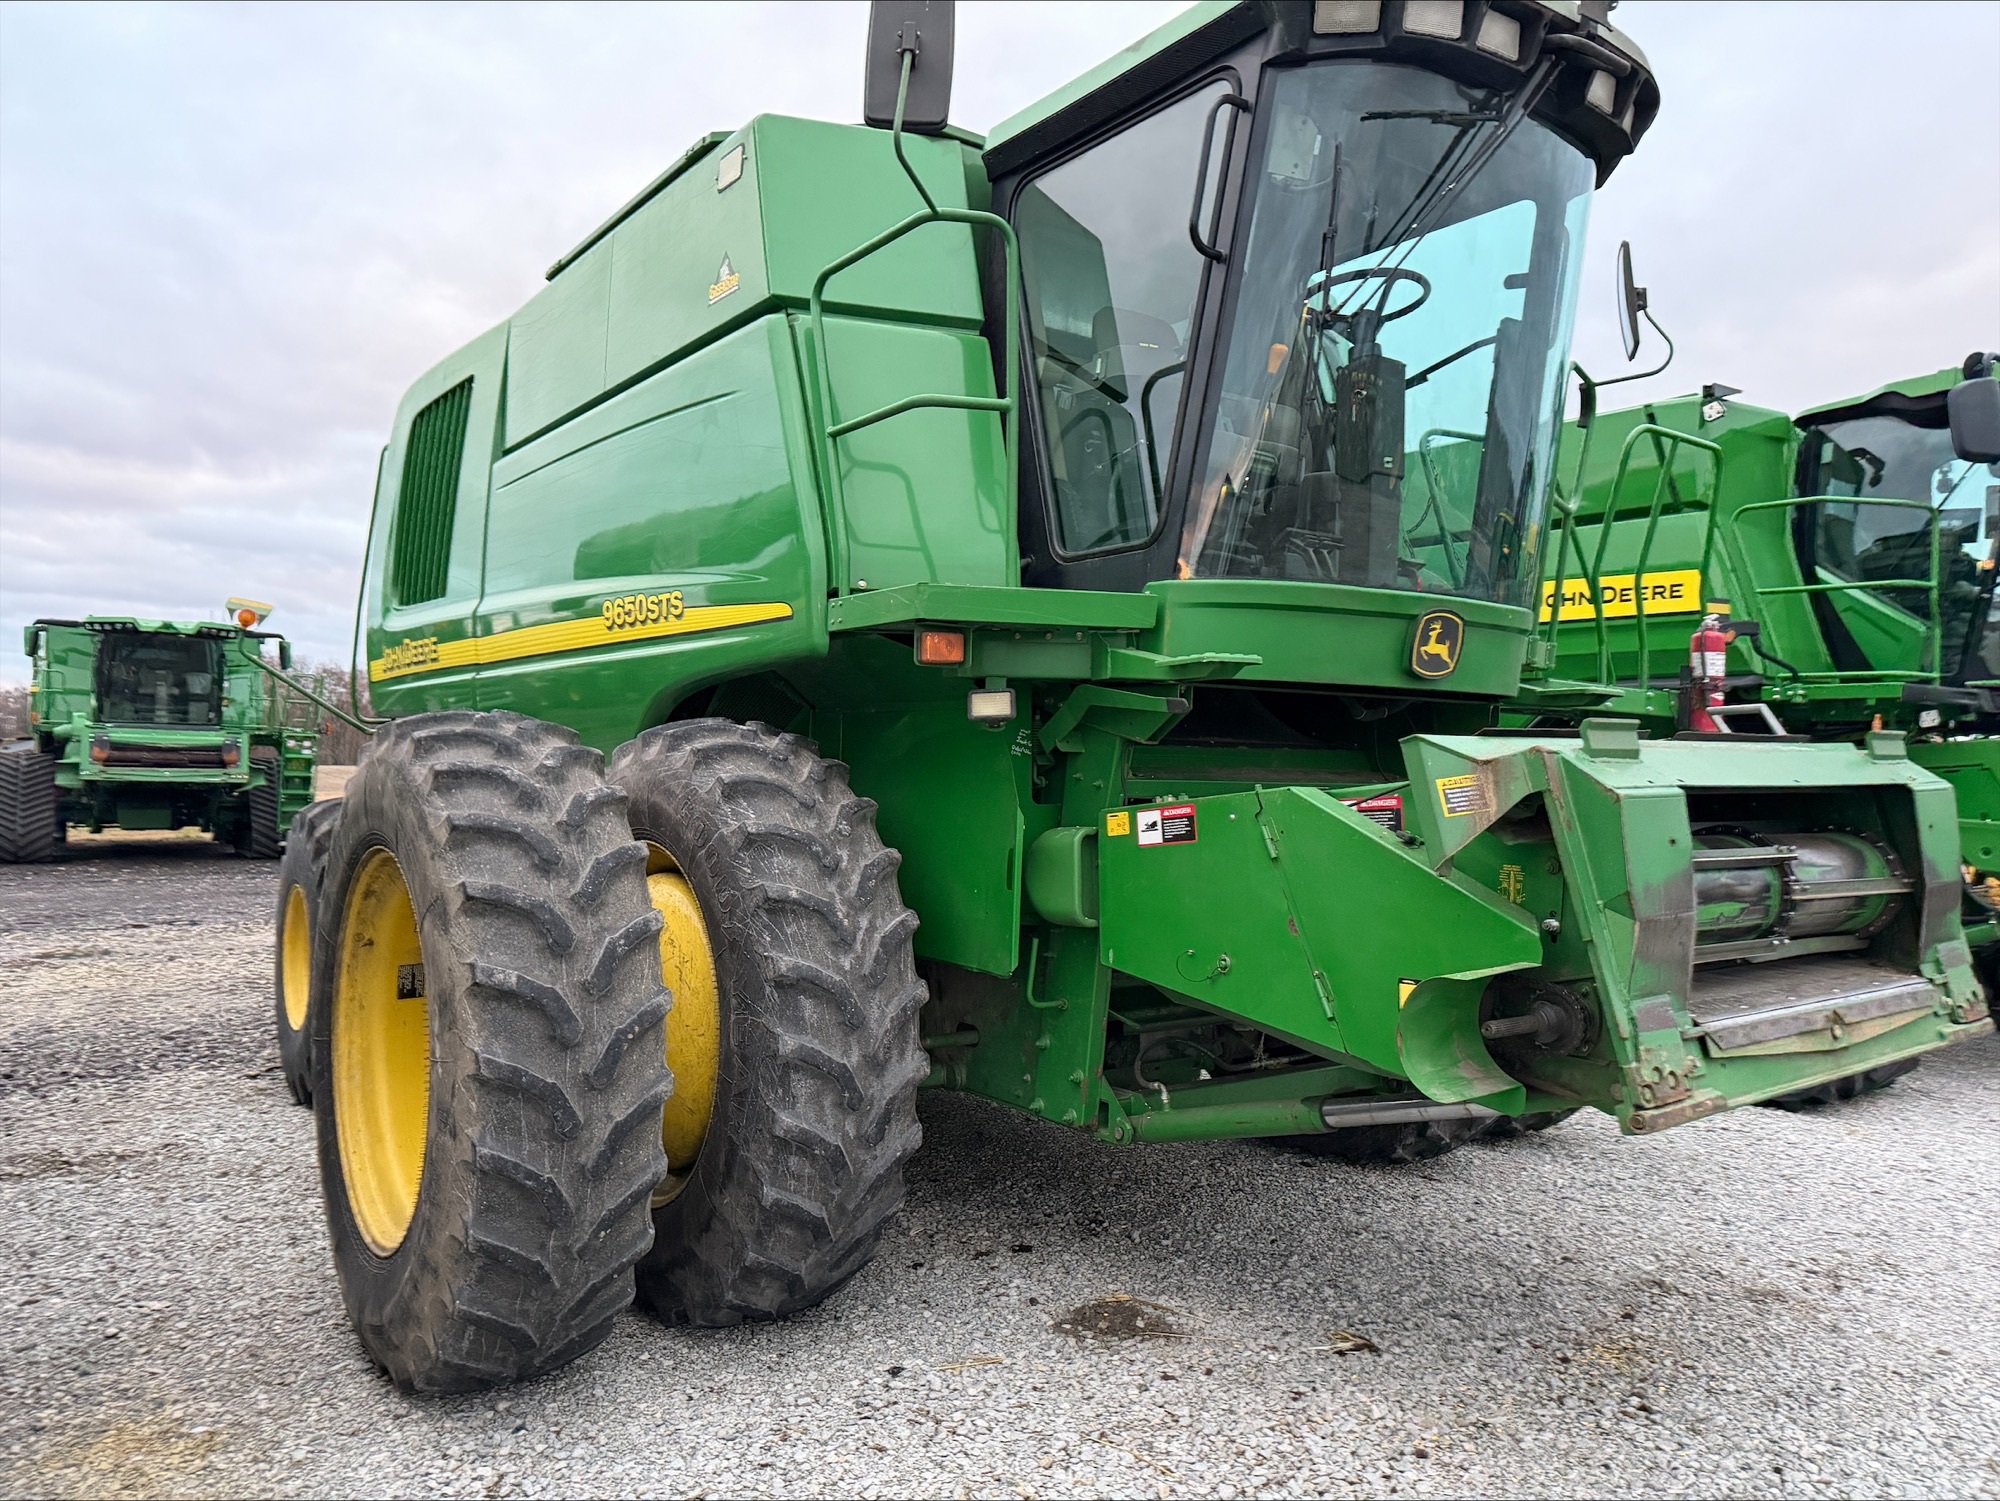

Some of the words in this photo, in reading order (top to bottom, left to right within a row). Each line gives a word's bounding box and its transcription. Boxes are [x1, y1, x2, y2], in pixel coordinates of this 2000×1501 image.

[602, 590, 684, 630] 9650STS
[1545, 592, 1594, 607] OHN
[1601, 583, 1684, 604] DEERE
